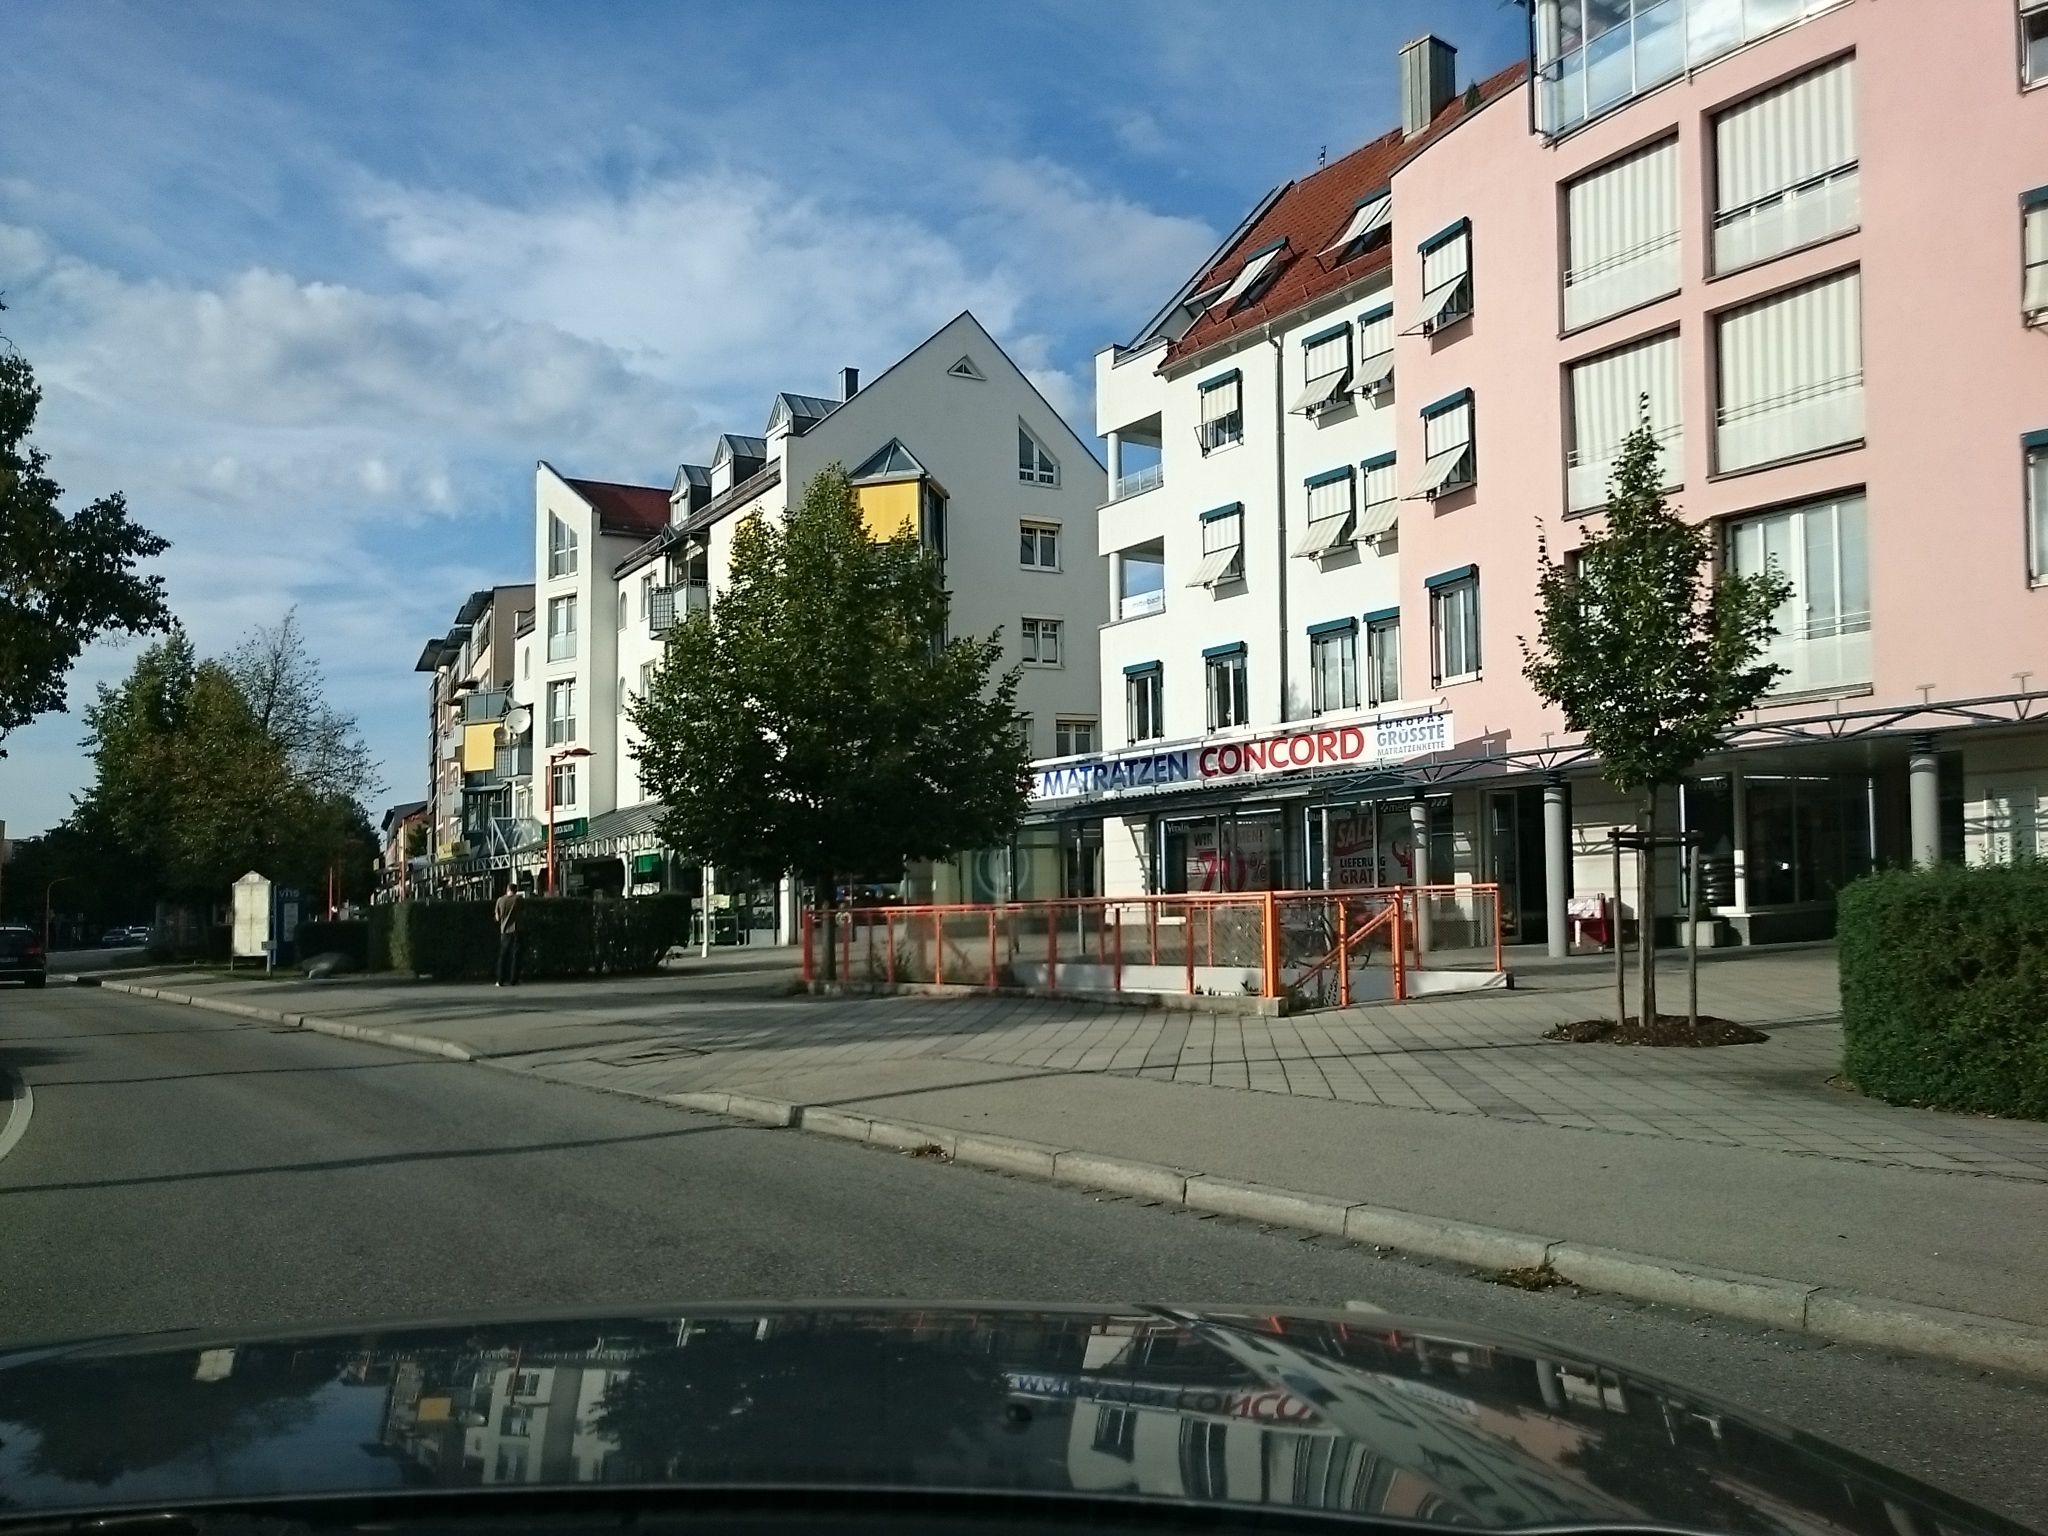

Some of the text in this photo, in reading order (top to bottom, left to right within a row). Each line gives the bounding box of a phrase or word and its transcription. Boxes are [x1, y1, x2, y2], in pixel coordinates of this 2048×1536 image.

[1376, 713, 1444, 731] EUROPAS
[1377, 724, 1445, 747] GRÜSSTE
[1377, 741, 1446, 757] MATRATZENKETTE
[1042, 727, 1365, 797] MATRATZEN CONCORD
[1340, 856, 1386, 868] LIEFERUG
[1340, 868, 1387, 884] GRATS
